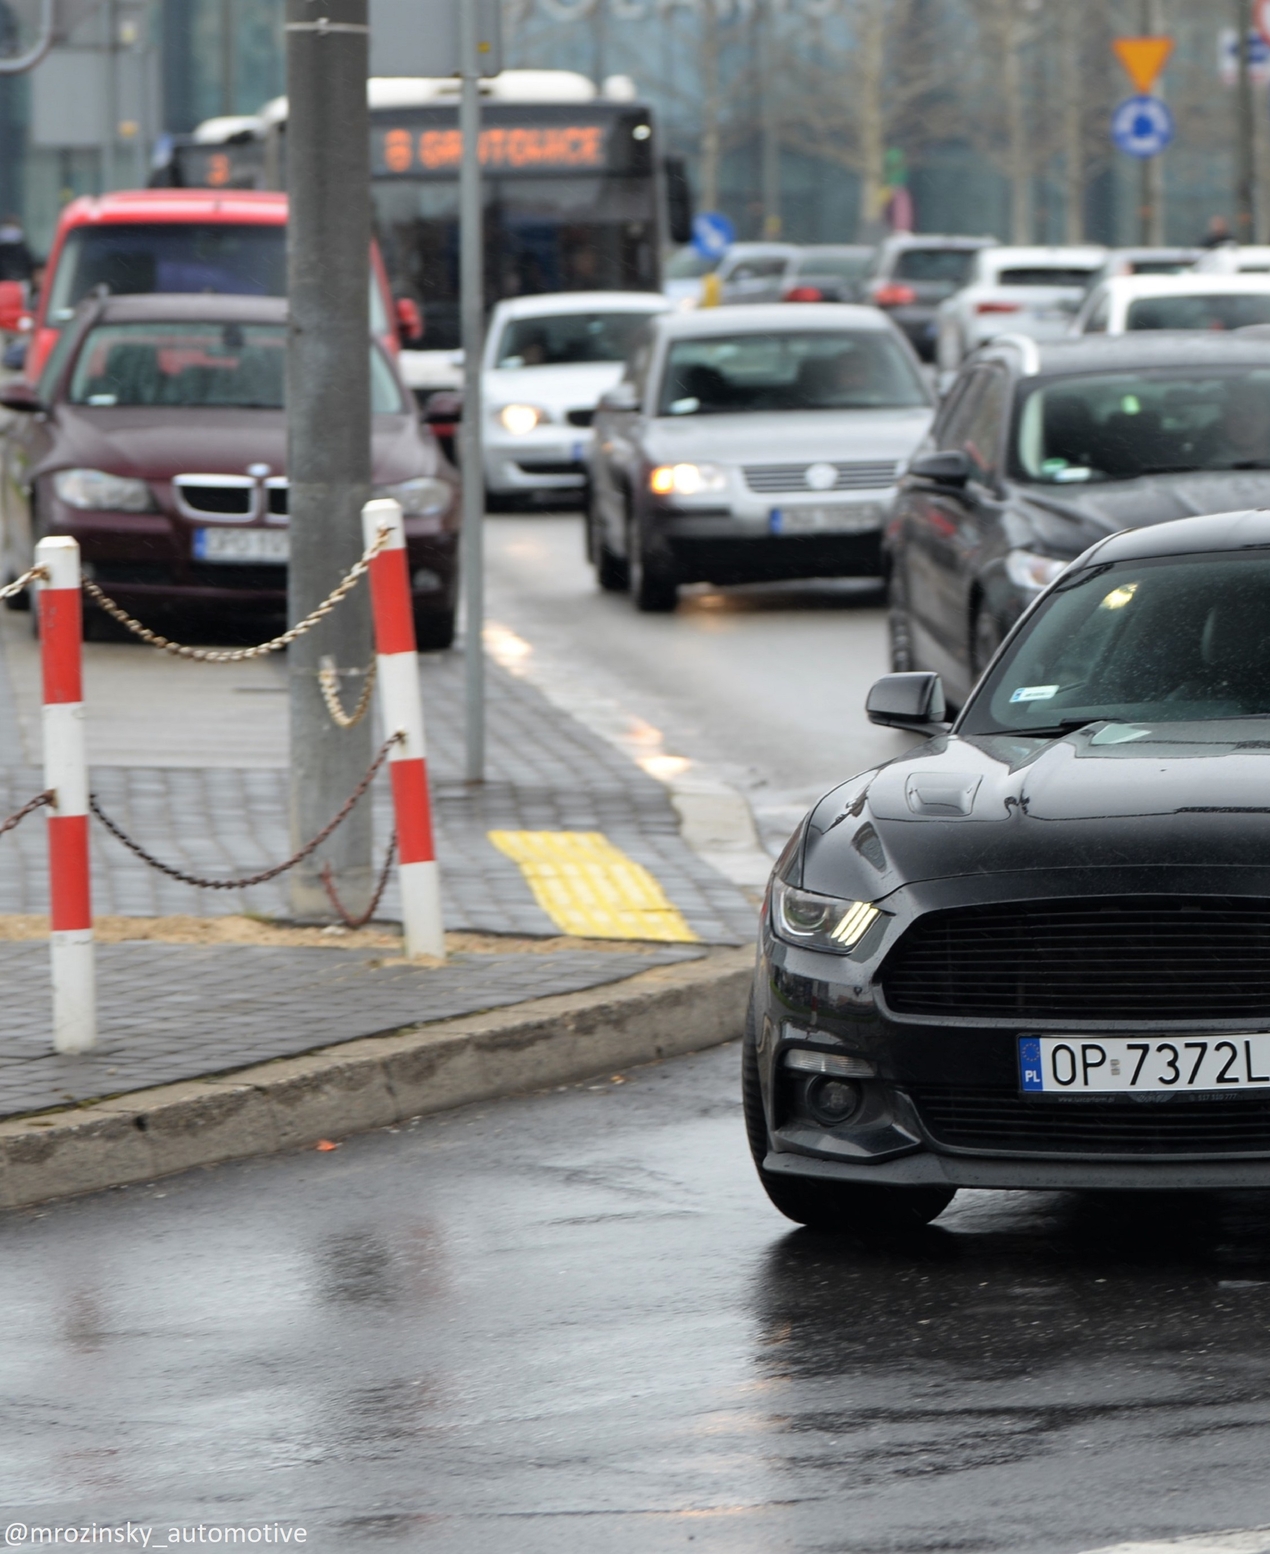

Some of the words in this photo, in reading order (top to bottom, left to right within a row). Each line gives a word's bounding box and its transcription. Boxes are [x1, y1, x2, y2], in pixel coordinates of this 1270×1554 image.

[1025, 1070, 1041, 1083] PL
[1051, 1043, 1107, 1086] OP
[1126, 1040, 1270, 1086] 7372L
